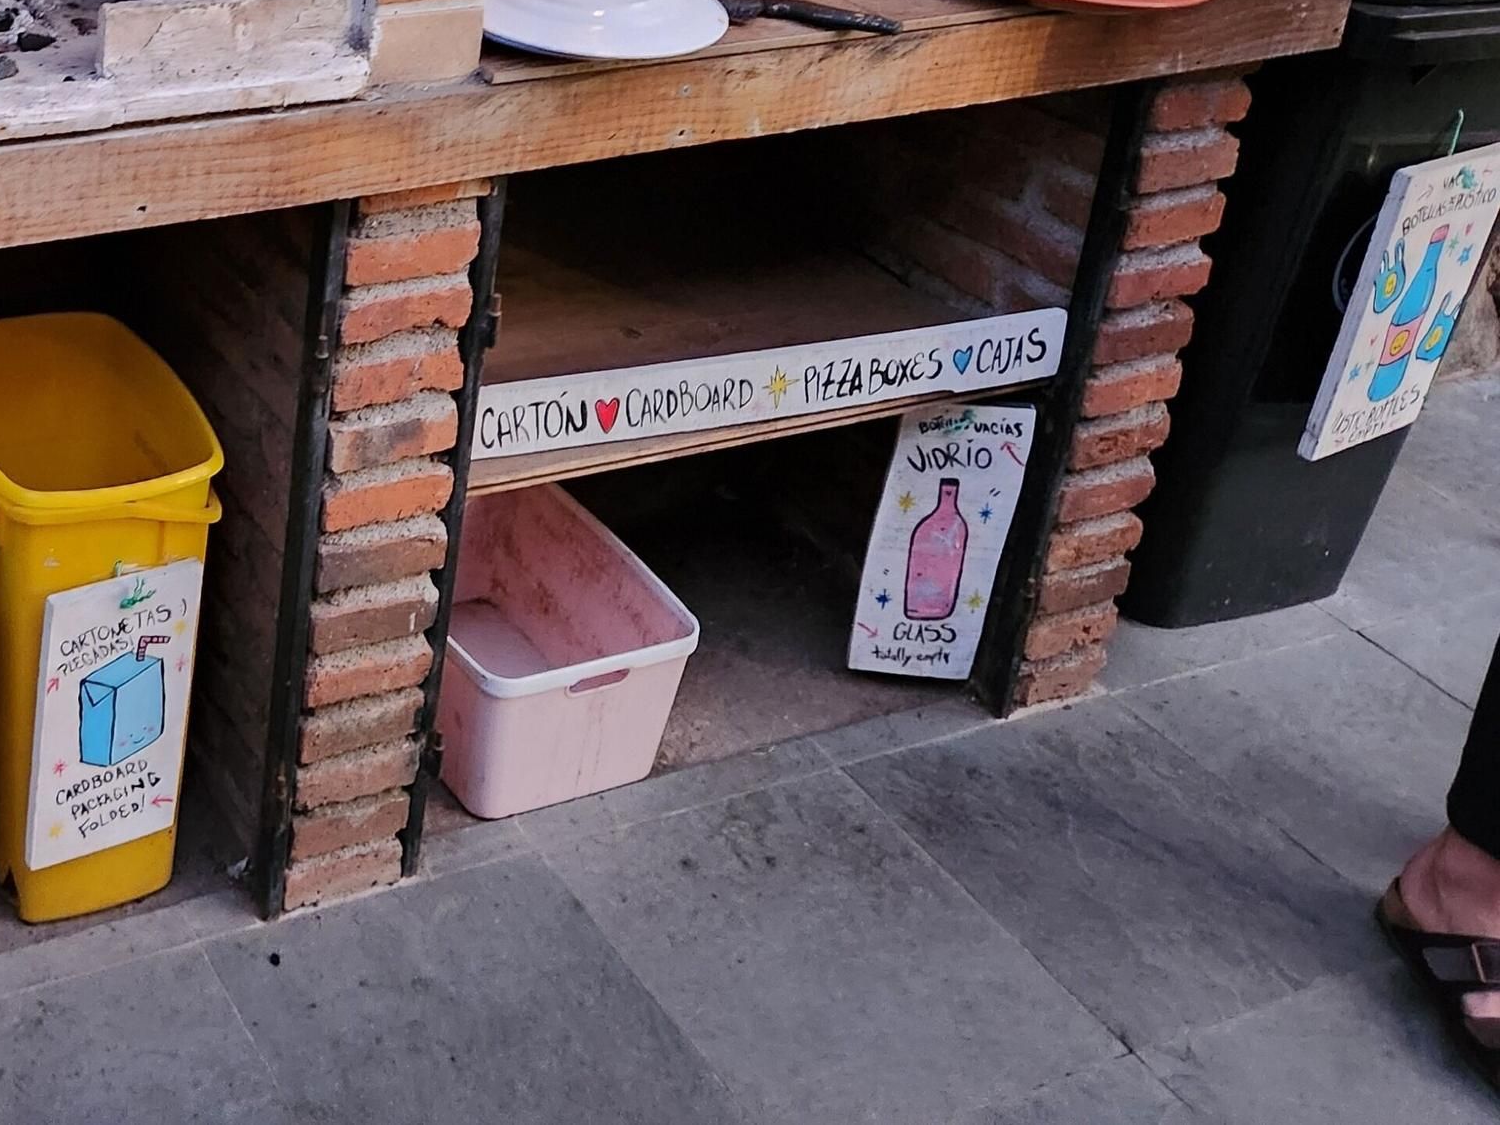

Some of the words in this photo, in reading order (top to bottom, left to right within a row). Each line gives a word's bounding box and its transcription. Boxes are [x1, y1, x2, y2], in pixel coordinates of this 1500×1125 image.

[480, 390, 588, 449] CARTÓN
[625, 378, 753, 427] CARDBOARD
[976, 327, 1047, 374] CAJAS
[871, 644, 912, 667] totally
[893, 621, 957, 644] GLASS
[55, 760, 148, 806] CARDBOARD
[71, 771, 161, 820] PACKAGING
